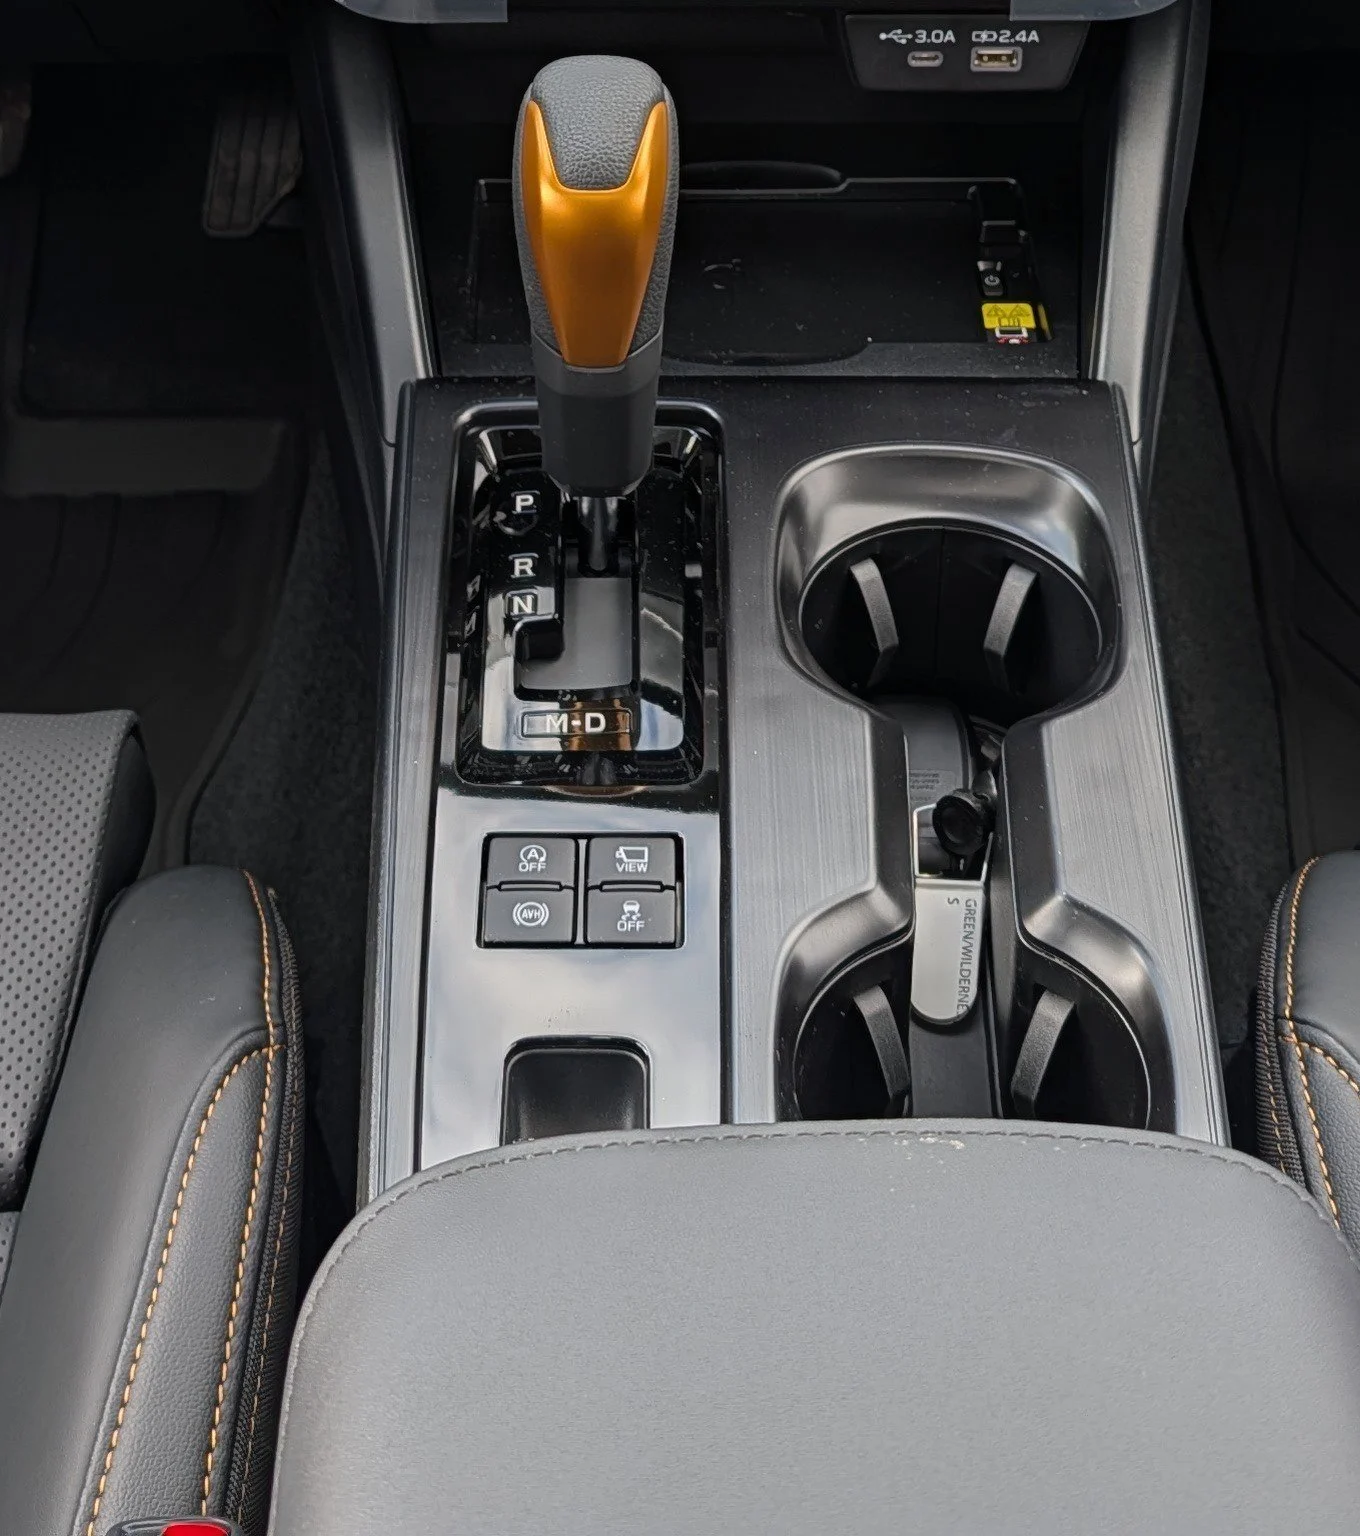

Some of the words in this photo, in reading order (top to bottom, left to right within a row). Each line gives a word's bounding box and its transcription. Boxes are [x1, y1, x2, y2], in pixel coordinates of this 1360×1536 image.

[915, 30, 956, 44] 3.0A
[998, 30, 1040, 44] 2.4A
[515, 494, 534, 513] P
[513, 558, 534, 576] R
[512, 595, 533, 614] N
[518, 862, 547, 872] OFF
[615, 862, 649, 873] VIEW
[521, 908, 541, 919] AVH
[616, 921, 645, 932] OFF
[956, 897, 978, 1017] GREEN/WILDERNE
